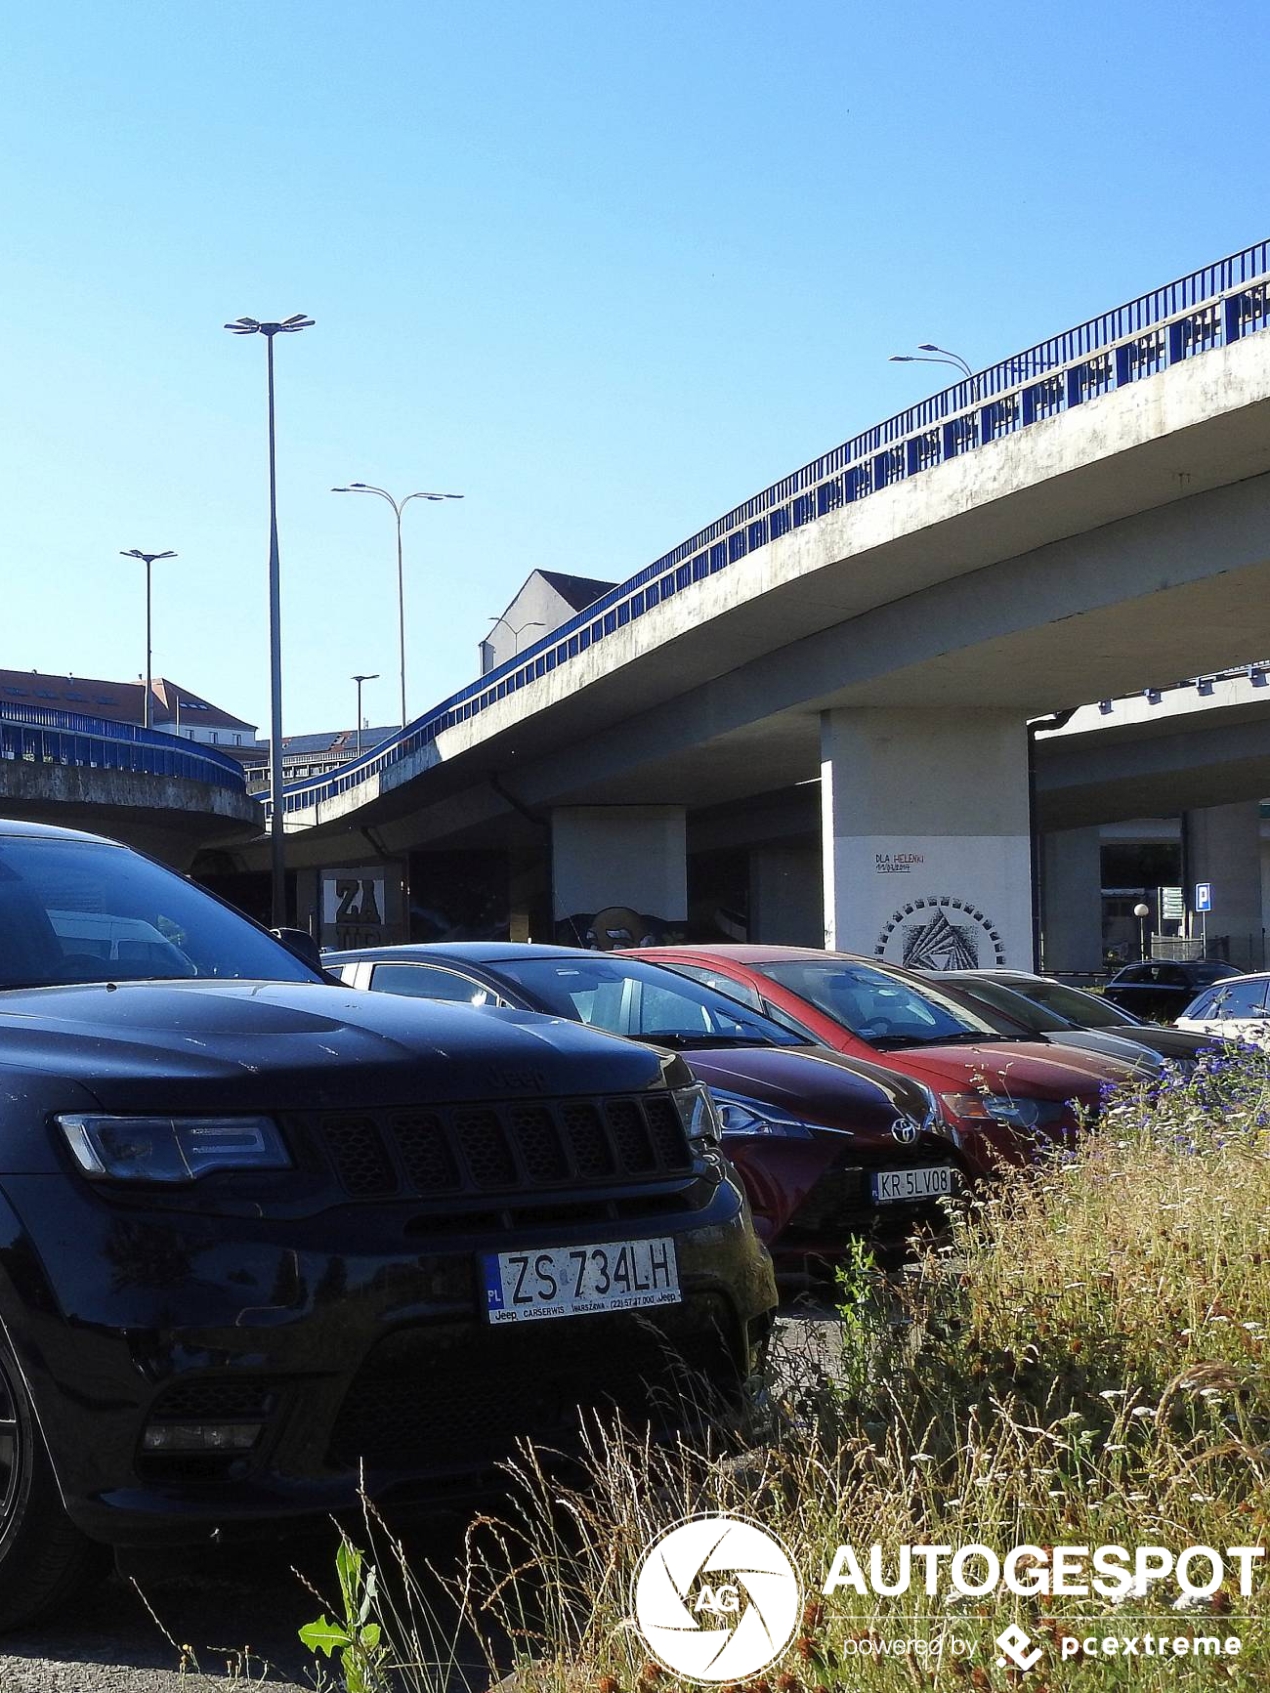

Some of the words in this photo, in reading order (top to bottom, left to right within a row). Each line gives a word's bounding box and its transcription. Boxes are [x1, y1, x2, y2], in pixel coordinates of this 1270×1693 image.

[875, 854, 890, 863] DLA
[1198, 886, 1208, 908] P
[881, 1174, 901, 1197] KR
[906, 1170, 948, 1195] 5LV08
[487, 1289, 501, 1303] PL
[508, 1254, 557, 1304] ZS
[569, 1243, 670, 1297] 734LH
[495, 1310, 517, 1322] Jeep
[523, 1305, 565, 1318] CARSERWIS
